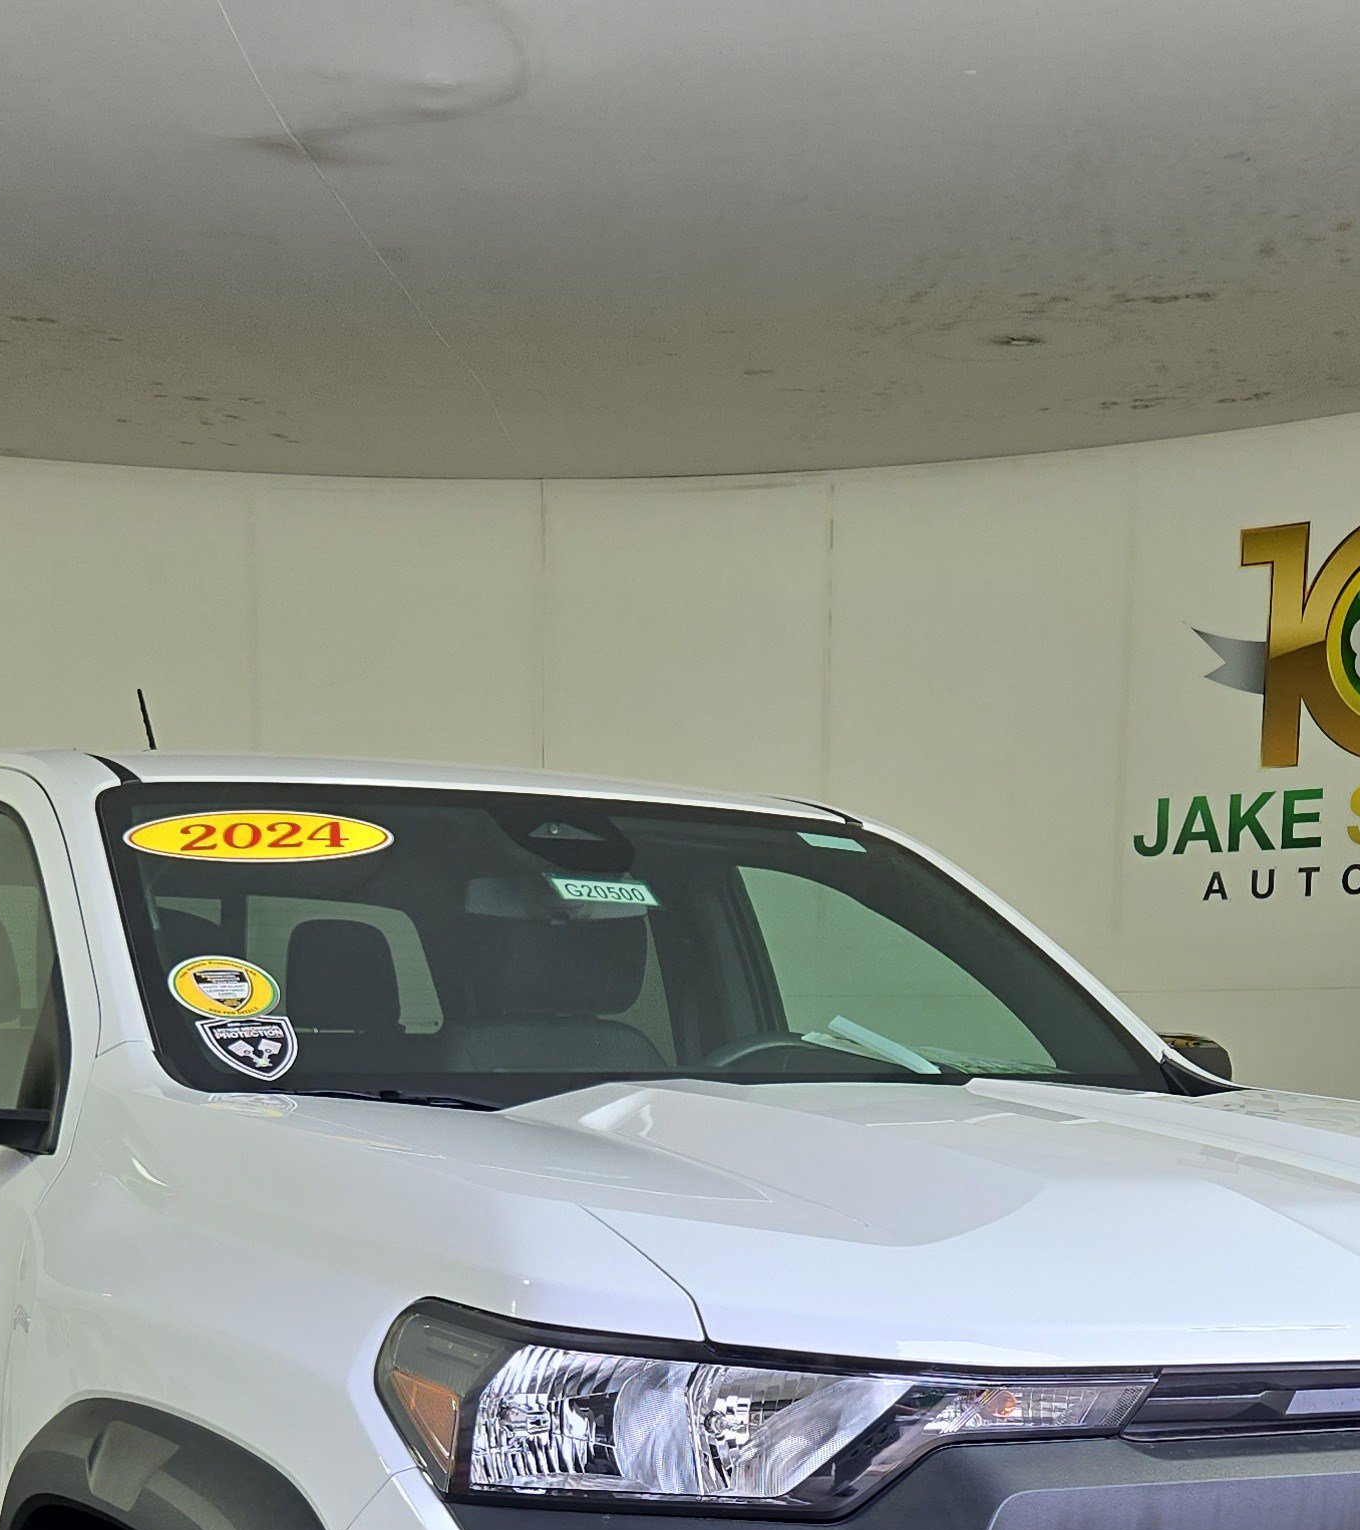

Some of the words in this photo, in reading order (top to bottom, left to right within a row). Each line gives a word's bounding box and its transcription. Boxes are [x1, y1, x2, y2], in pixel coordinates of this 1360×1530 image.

[179, 821, 350, 851] 2024
[1132, 787, 1324, 858] JAKE
[564, 883, 646, 902] G20500
